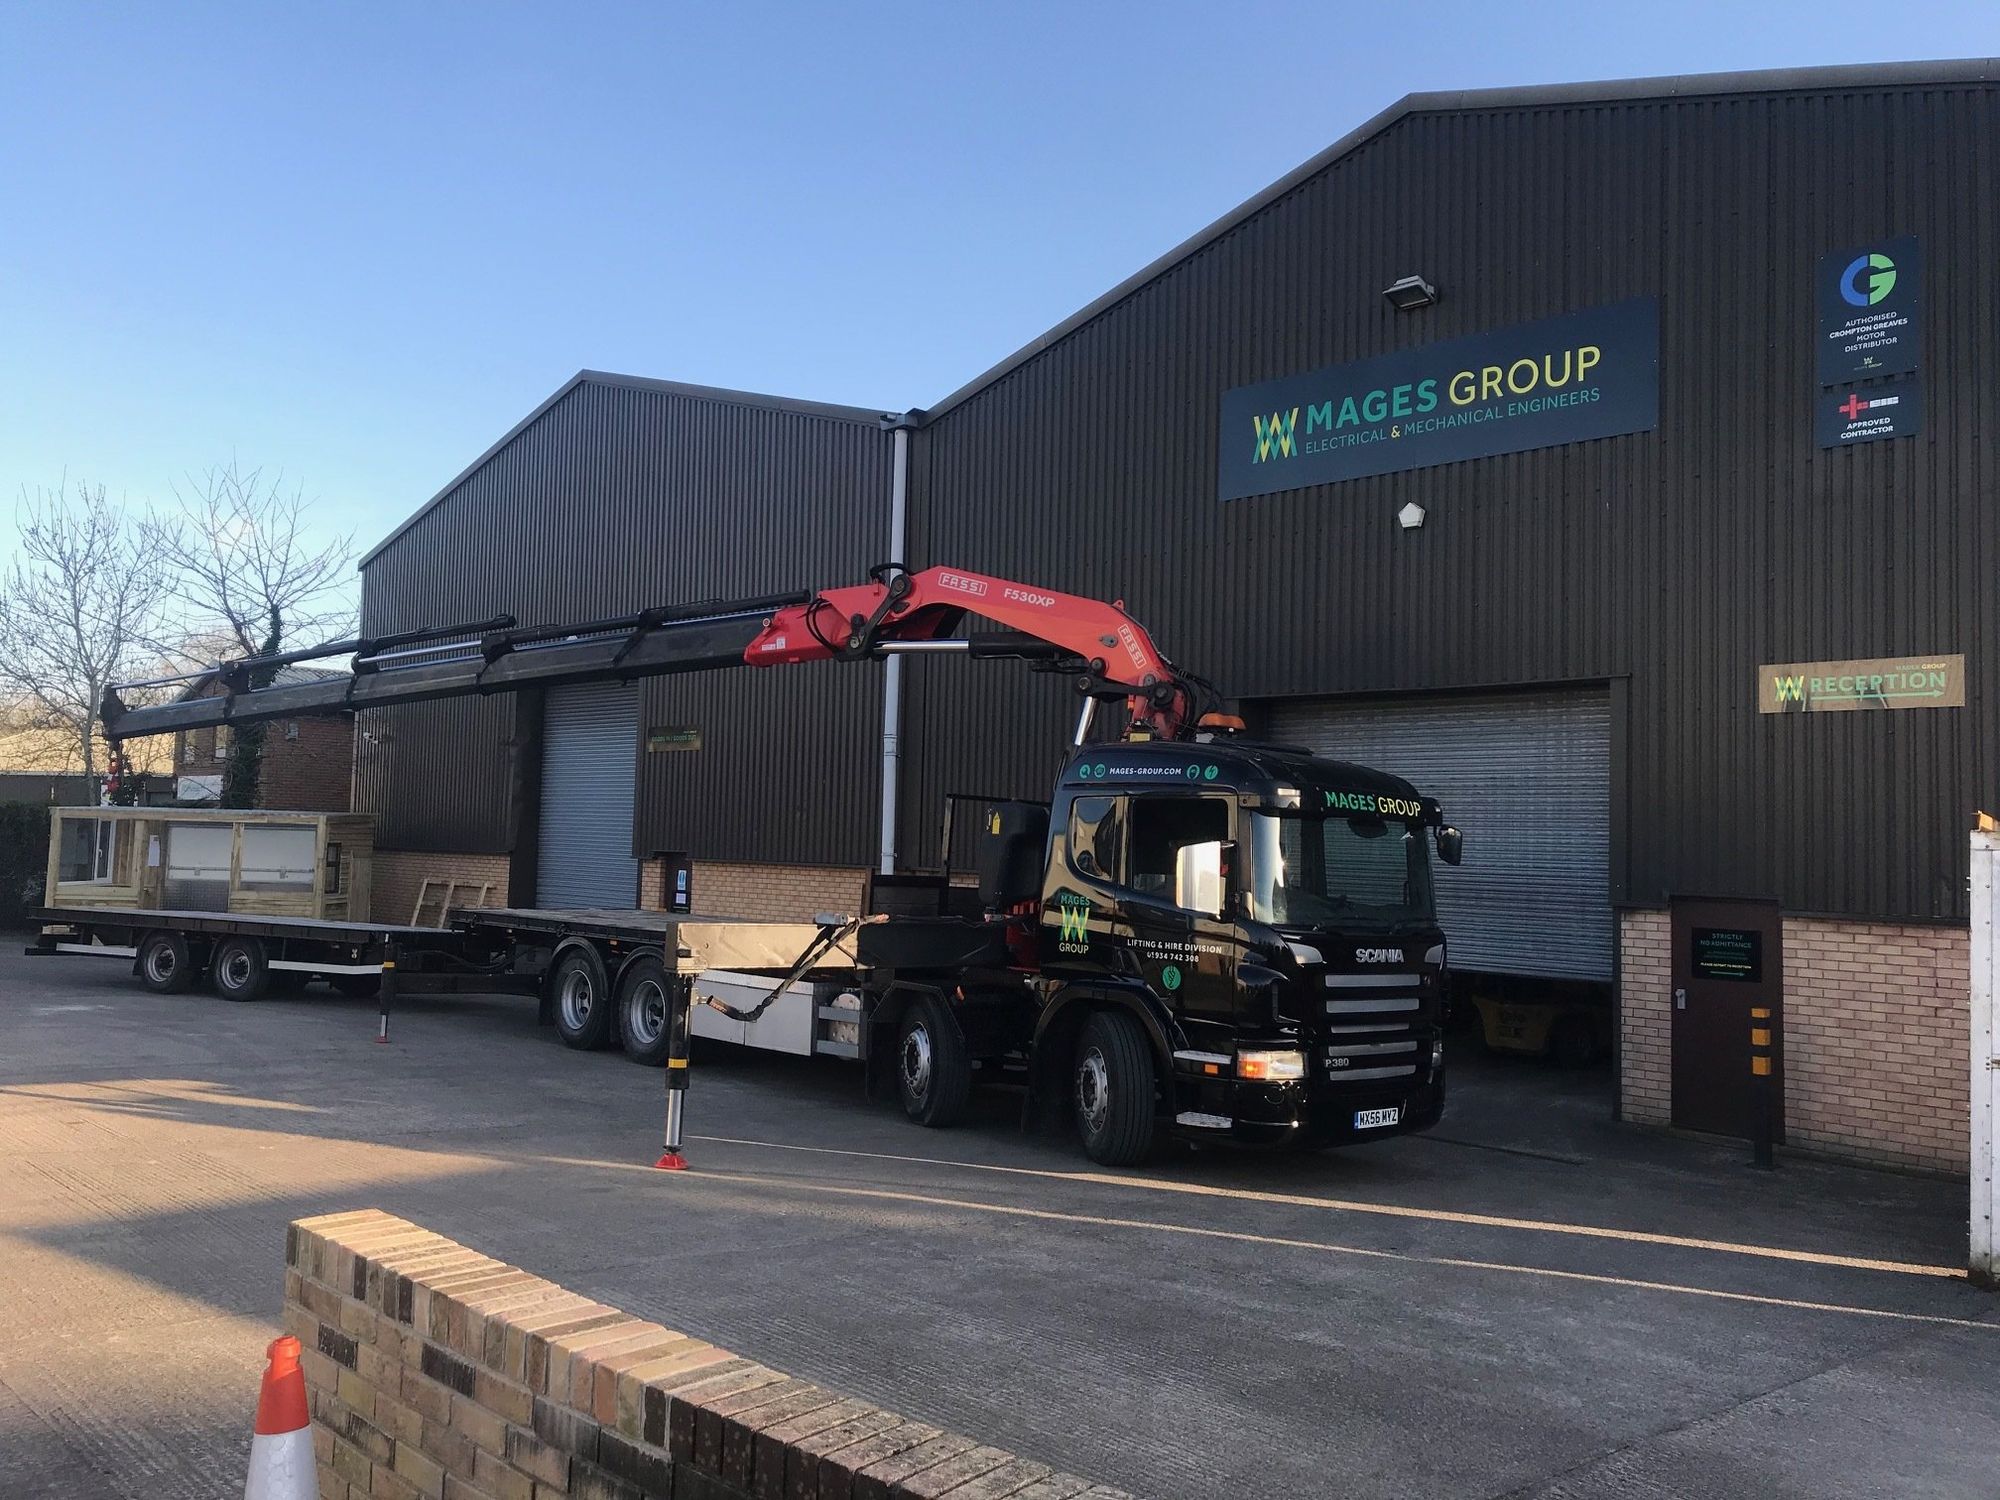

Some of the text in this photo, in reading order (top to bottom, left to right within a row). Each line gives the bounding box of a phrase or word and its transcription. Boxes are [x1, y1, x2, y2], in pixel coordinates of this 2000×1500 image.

[1845, 311, 1897, 328] AUTHORISED
[1829, 317, 1908, 339] CROMPTON GREAVES
[1856, 330, 1886, 342] MOTOR
[1844, 336, 1898, 353] DISTRIBUTOR
[1306, 346, 1601, 435] MAGES GROUP
[1306, 387, 1600, 454] ELECTRICAL & MECHANICAL ENGINEERS
[1847, 417, 1891, 430] APPROVED
[1840, 425, 1894, 439] CONTRACTOR
[941, 574, 984, 593] FASSI
[1004, 588, 1055, 607] F530XP
[1119, 626, 1146, 666] FASSI
[1921, 663, 1946, 671] GROUP
[1810, 671, 1946, 693] RECEPTION
[1109, 767, 1182, 775] MAGES-GROUP.COM
[1325, 791, 1421, 817] MAGES GROUP
[1060, 895, 1090, 906] MAGES
[1059, 942, 1089, 954] GROUP
[1127, 939, 1156, 948] LIFTING
[1164, 942, 1183, 951] HIRE
[1184, 943, 1222, 954] DIVISION
[1170, 953, 1183, 961] 742
[1185, 954, 1199, 962] 308
[1355, 948, 1405, 963] SCANIA
